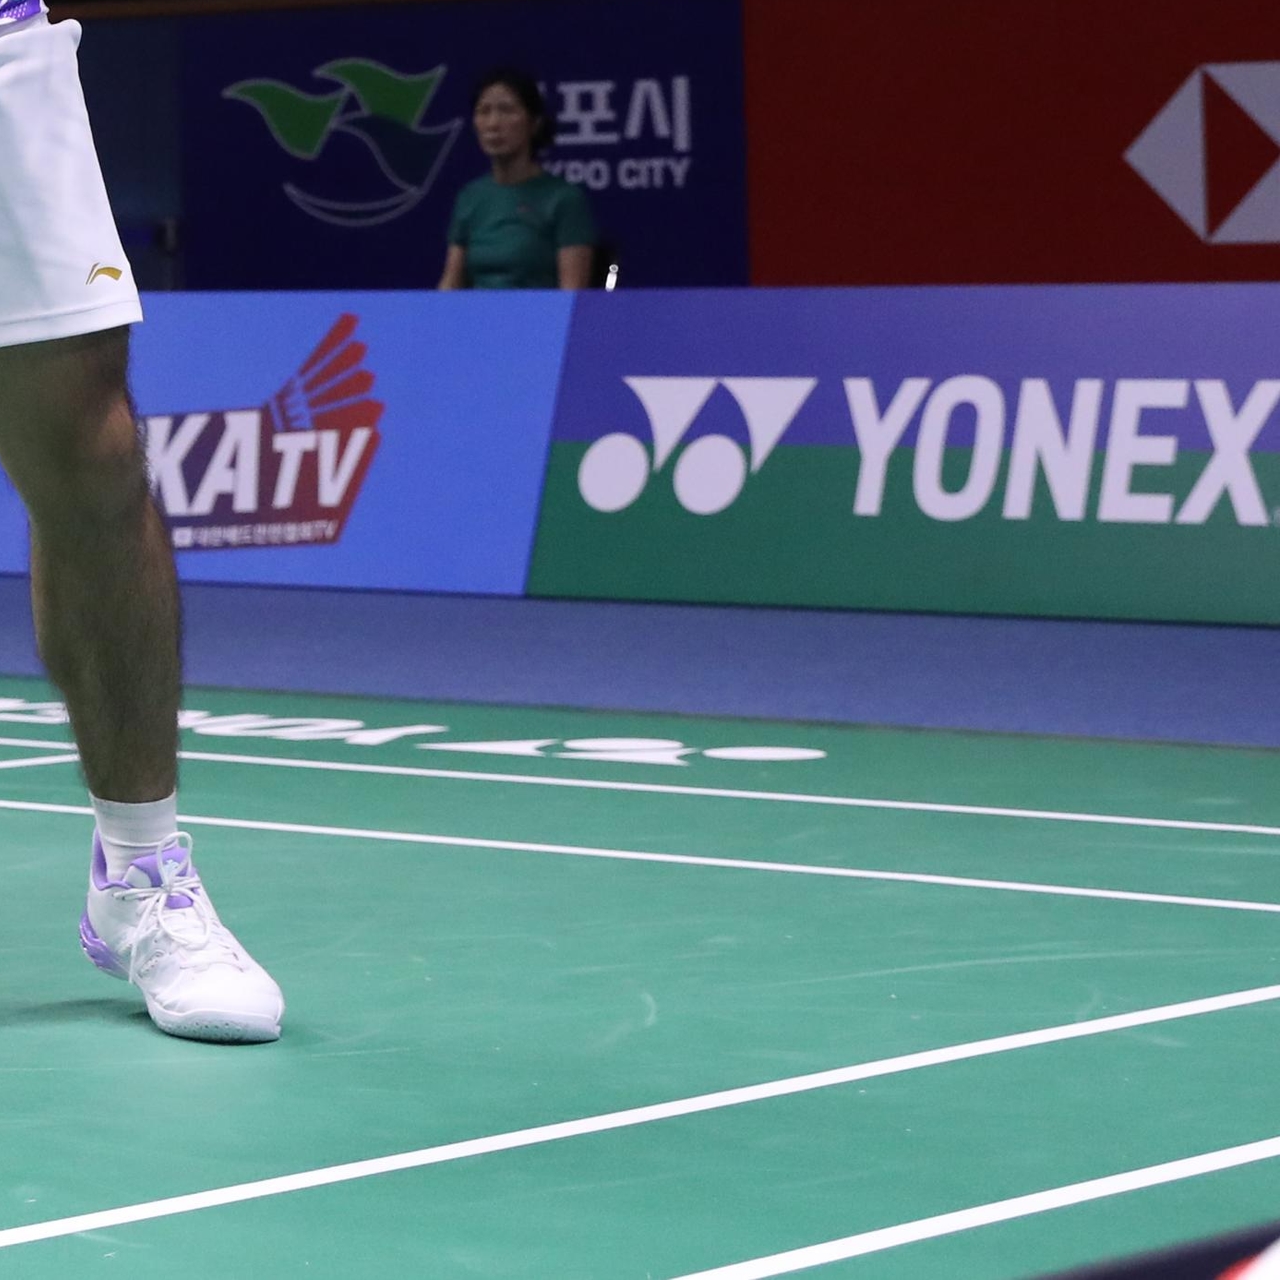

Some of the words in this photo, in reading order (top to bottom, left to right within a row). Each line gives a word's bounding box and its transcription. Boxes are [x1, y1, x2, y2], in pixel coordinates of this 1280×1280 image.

[538, 75, 690, 152] 포시
[617, 157, 690, 189] CITY
[842, 374, 1280, 527] YONEX
